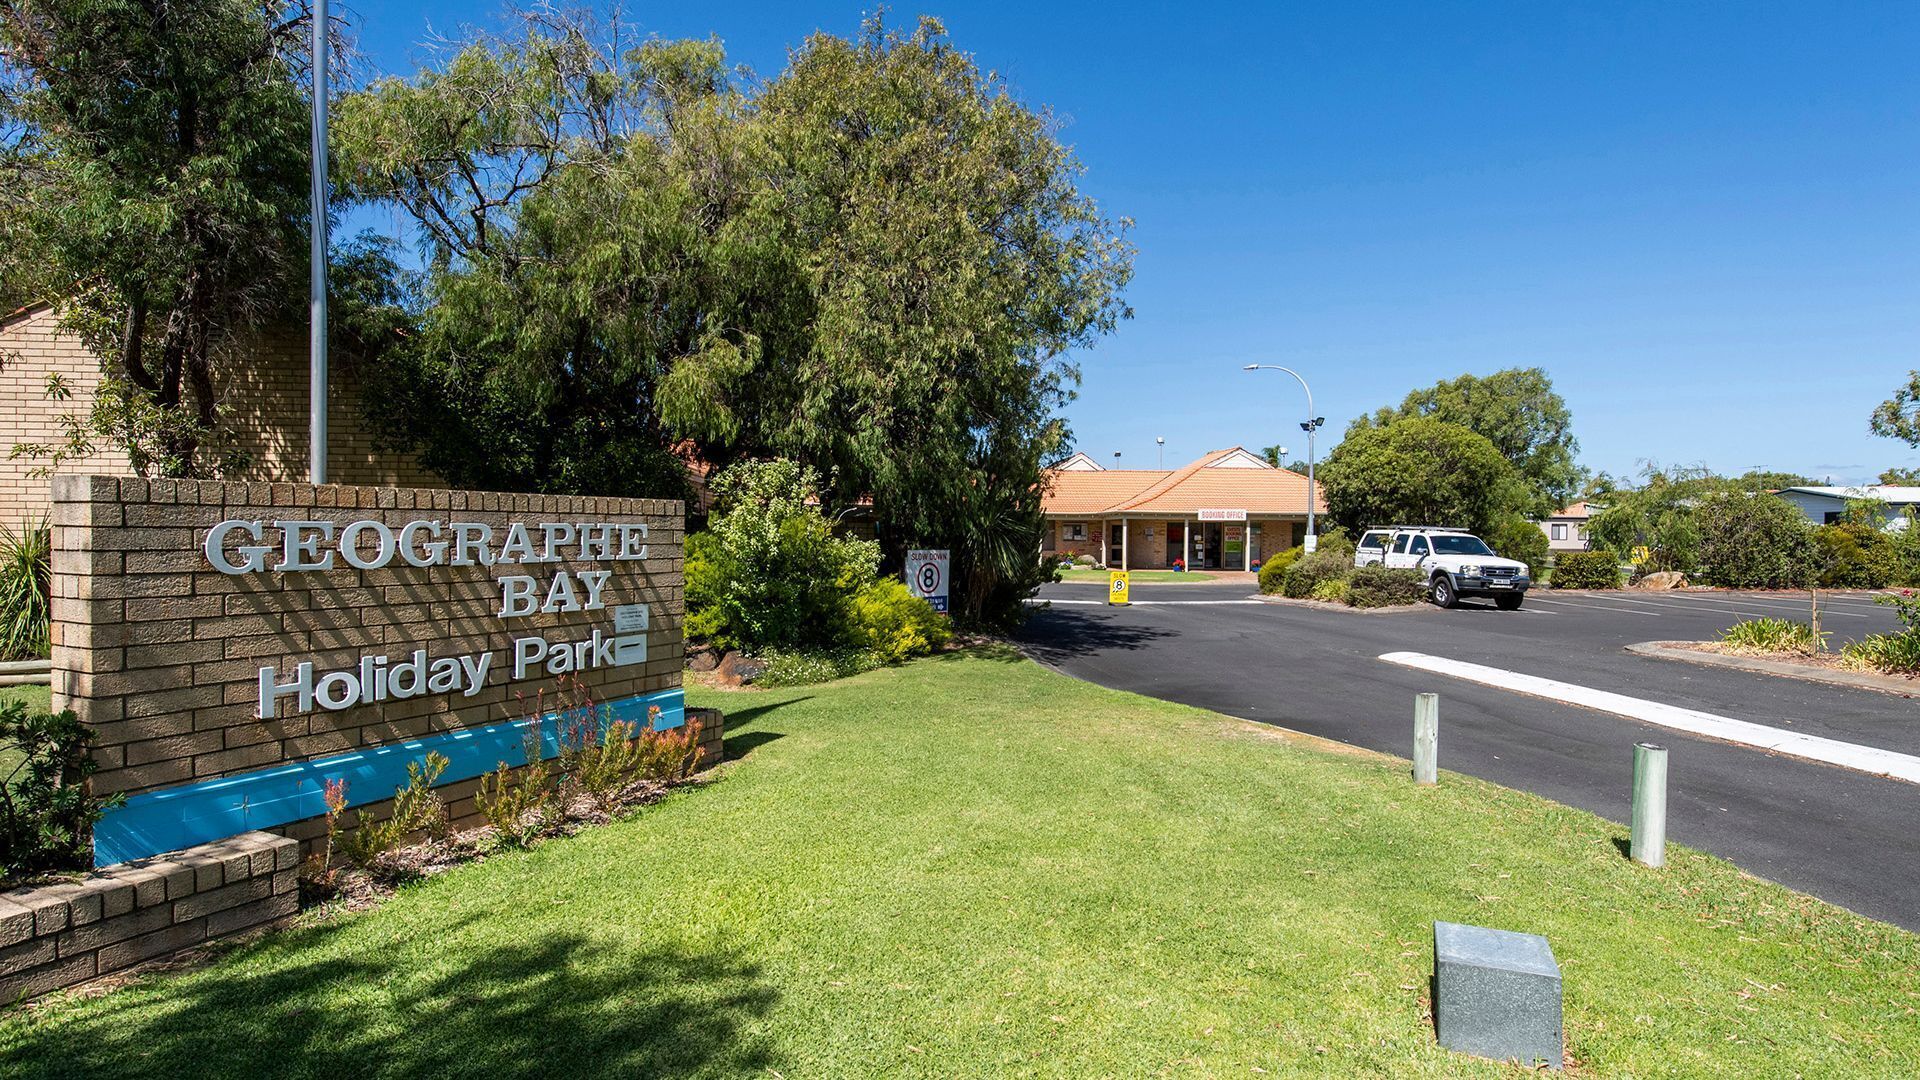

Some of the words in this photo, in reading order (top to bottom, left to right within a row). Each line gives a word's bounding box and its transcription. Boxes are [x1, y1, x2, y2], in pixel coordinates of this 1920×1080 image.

[1202, 511, 1225, 519] BOOKING
[1227, 511, 1244, 519] OFFICE
[204, 519, 649, 575] GEOGRAPHE
[497, 570, 612, 619] BAY
[923, 568, 934, 588] 8
[1116, 580, 1123, 590] 8
[257, 649, 493, 720] Holiday
[513, 629, 616, 680] Park
